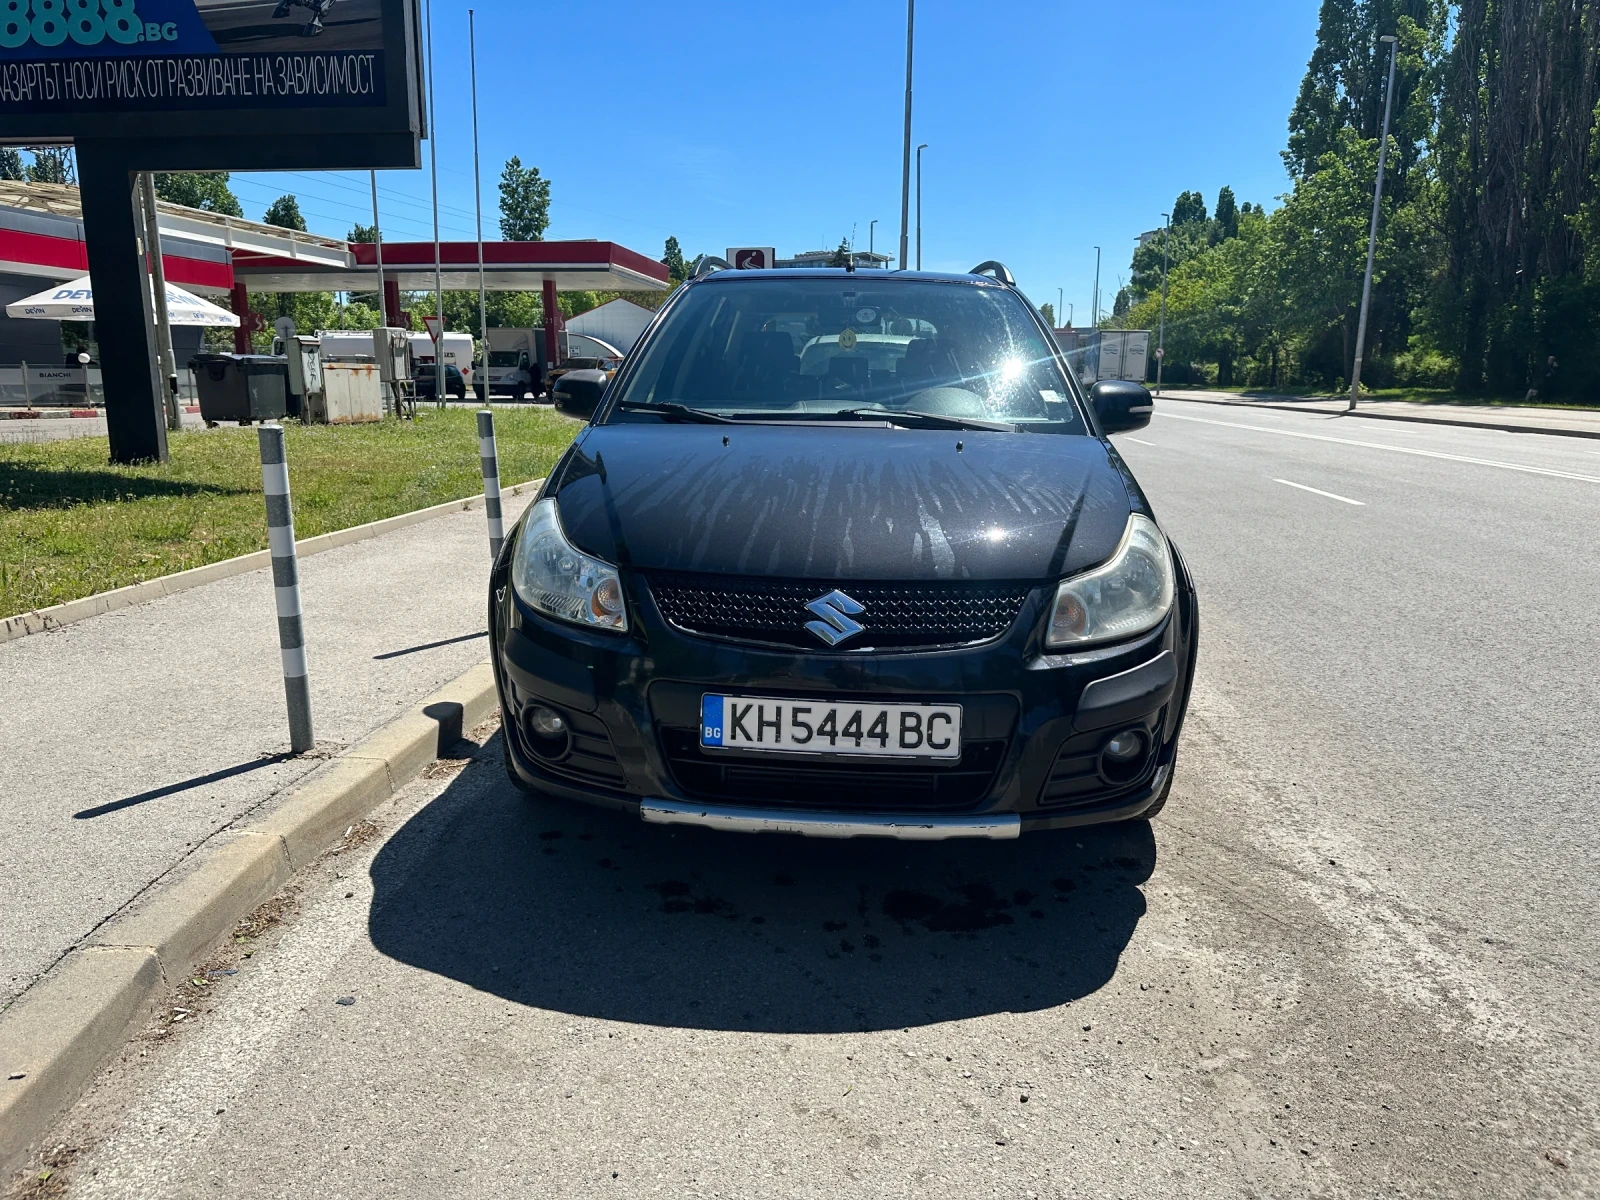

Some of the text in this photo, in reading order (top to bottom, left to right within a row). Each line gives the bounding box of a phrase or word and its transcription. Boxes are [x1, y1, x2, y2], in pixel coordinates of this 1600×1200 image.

[0, 54, 375, 101] АЗАРТЪТ НОСИ РИСК ОТ РАЗВИВАНЕ НА ЗАВИСИМОСТ
[25, 306, 93, 315] DEVIN DEVIN
[704, 726, 722, 739] BG
